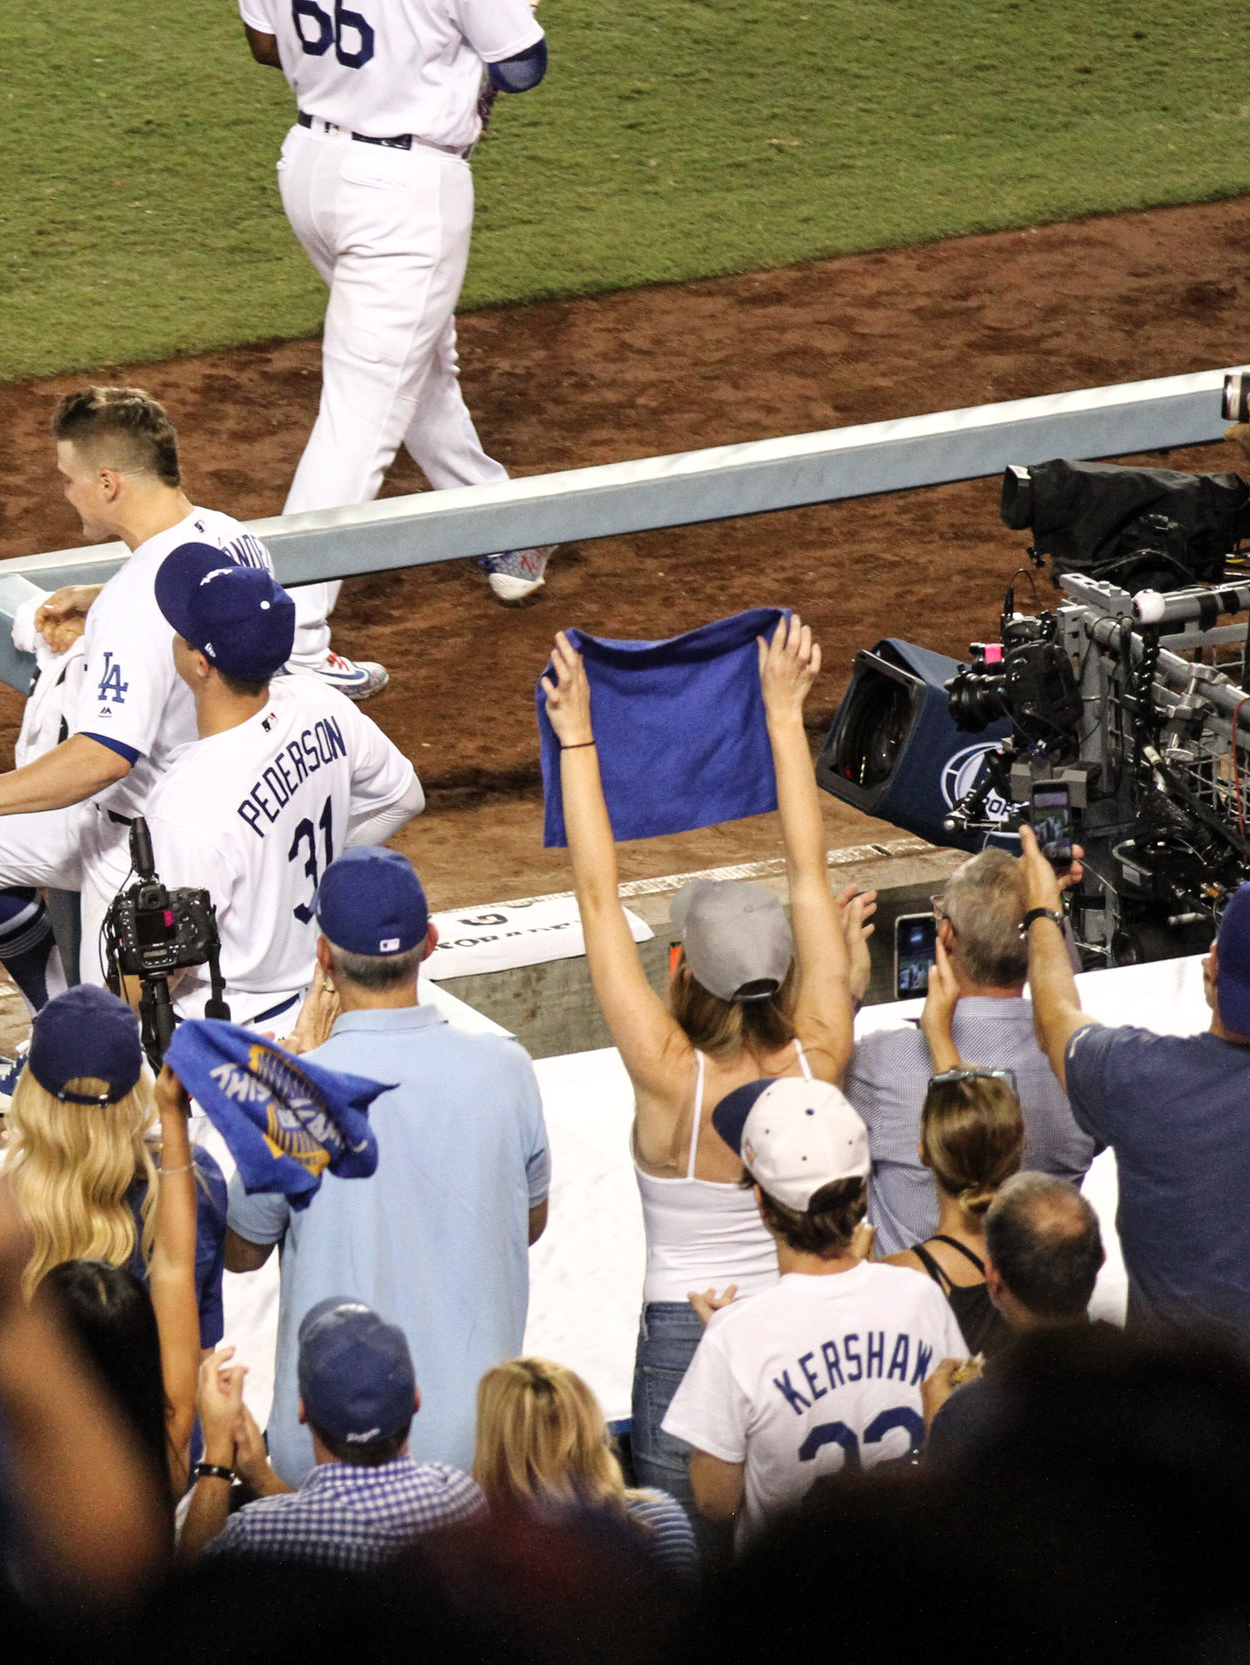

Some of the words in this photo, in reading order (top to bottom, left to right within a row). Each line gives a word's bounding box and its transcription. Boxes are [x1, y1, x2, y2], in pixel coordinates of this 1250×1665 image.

[291, 0, 375, 70] 66
[97, 651, 130, 704] LA
[237, 716, 348, 839] PEDERSON
[773, 1331, 934, 1416] KERSHAW
